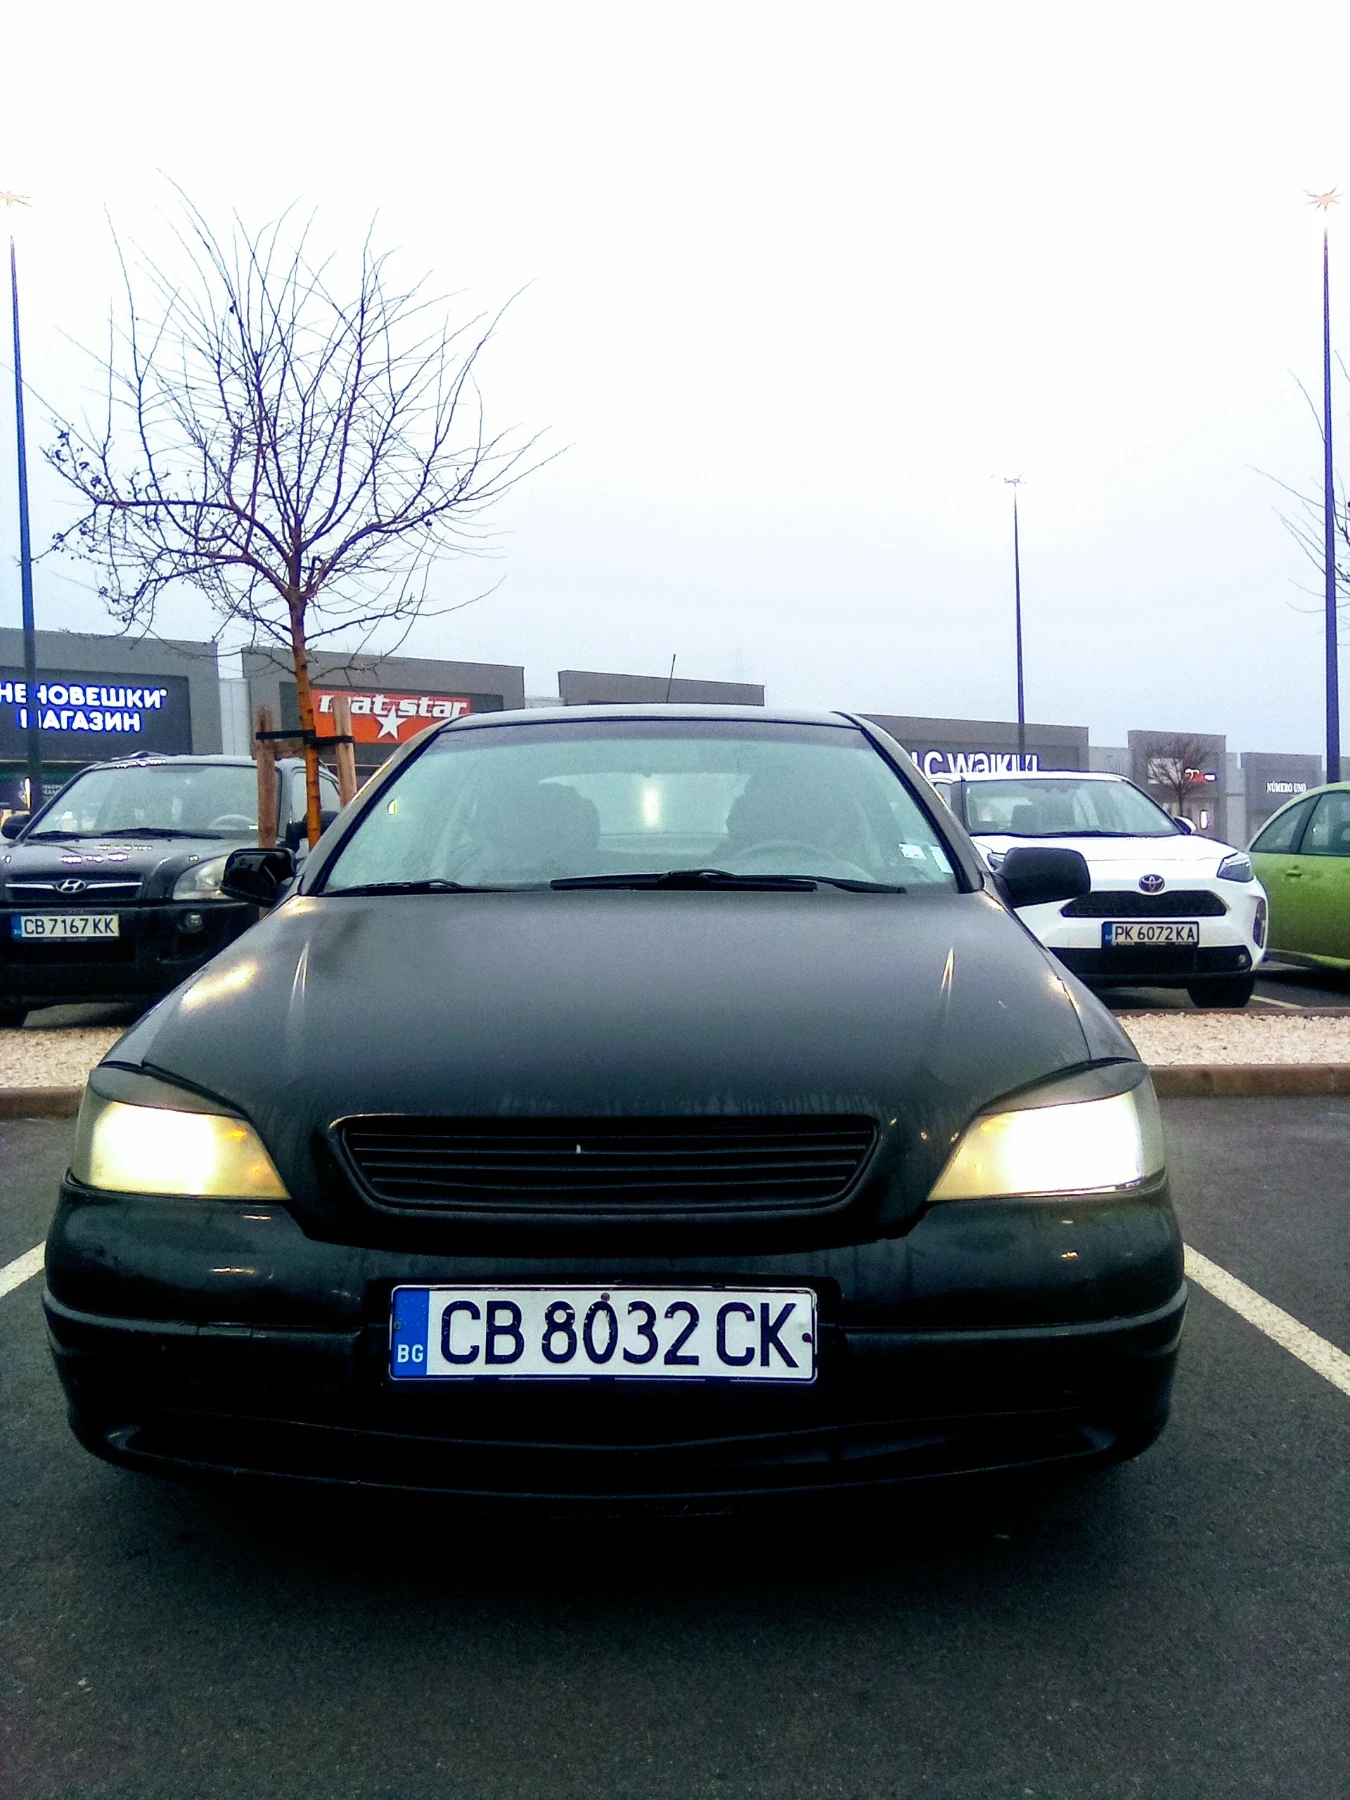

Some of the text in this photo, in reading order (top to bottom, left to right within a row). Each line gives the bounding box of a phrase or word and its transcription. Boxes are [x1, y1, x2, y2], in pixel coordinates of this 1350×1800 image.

[398, 697, 467, 718] star
[1294, 783, 1307, 793] UNO
[48, 918, 88, 934] 7167
[1137, 926, 1173, 941] 6072
[541, 1300, 700, 1366] 8032
[396, 1343, 424, 1364] BG
